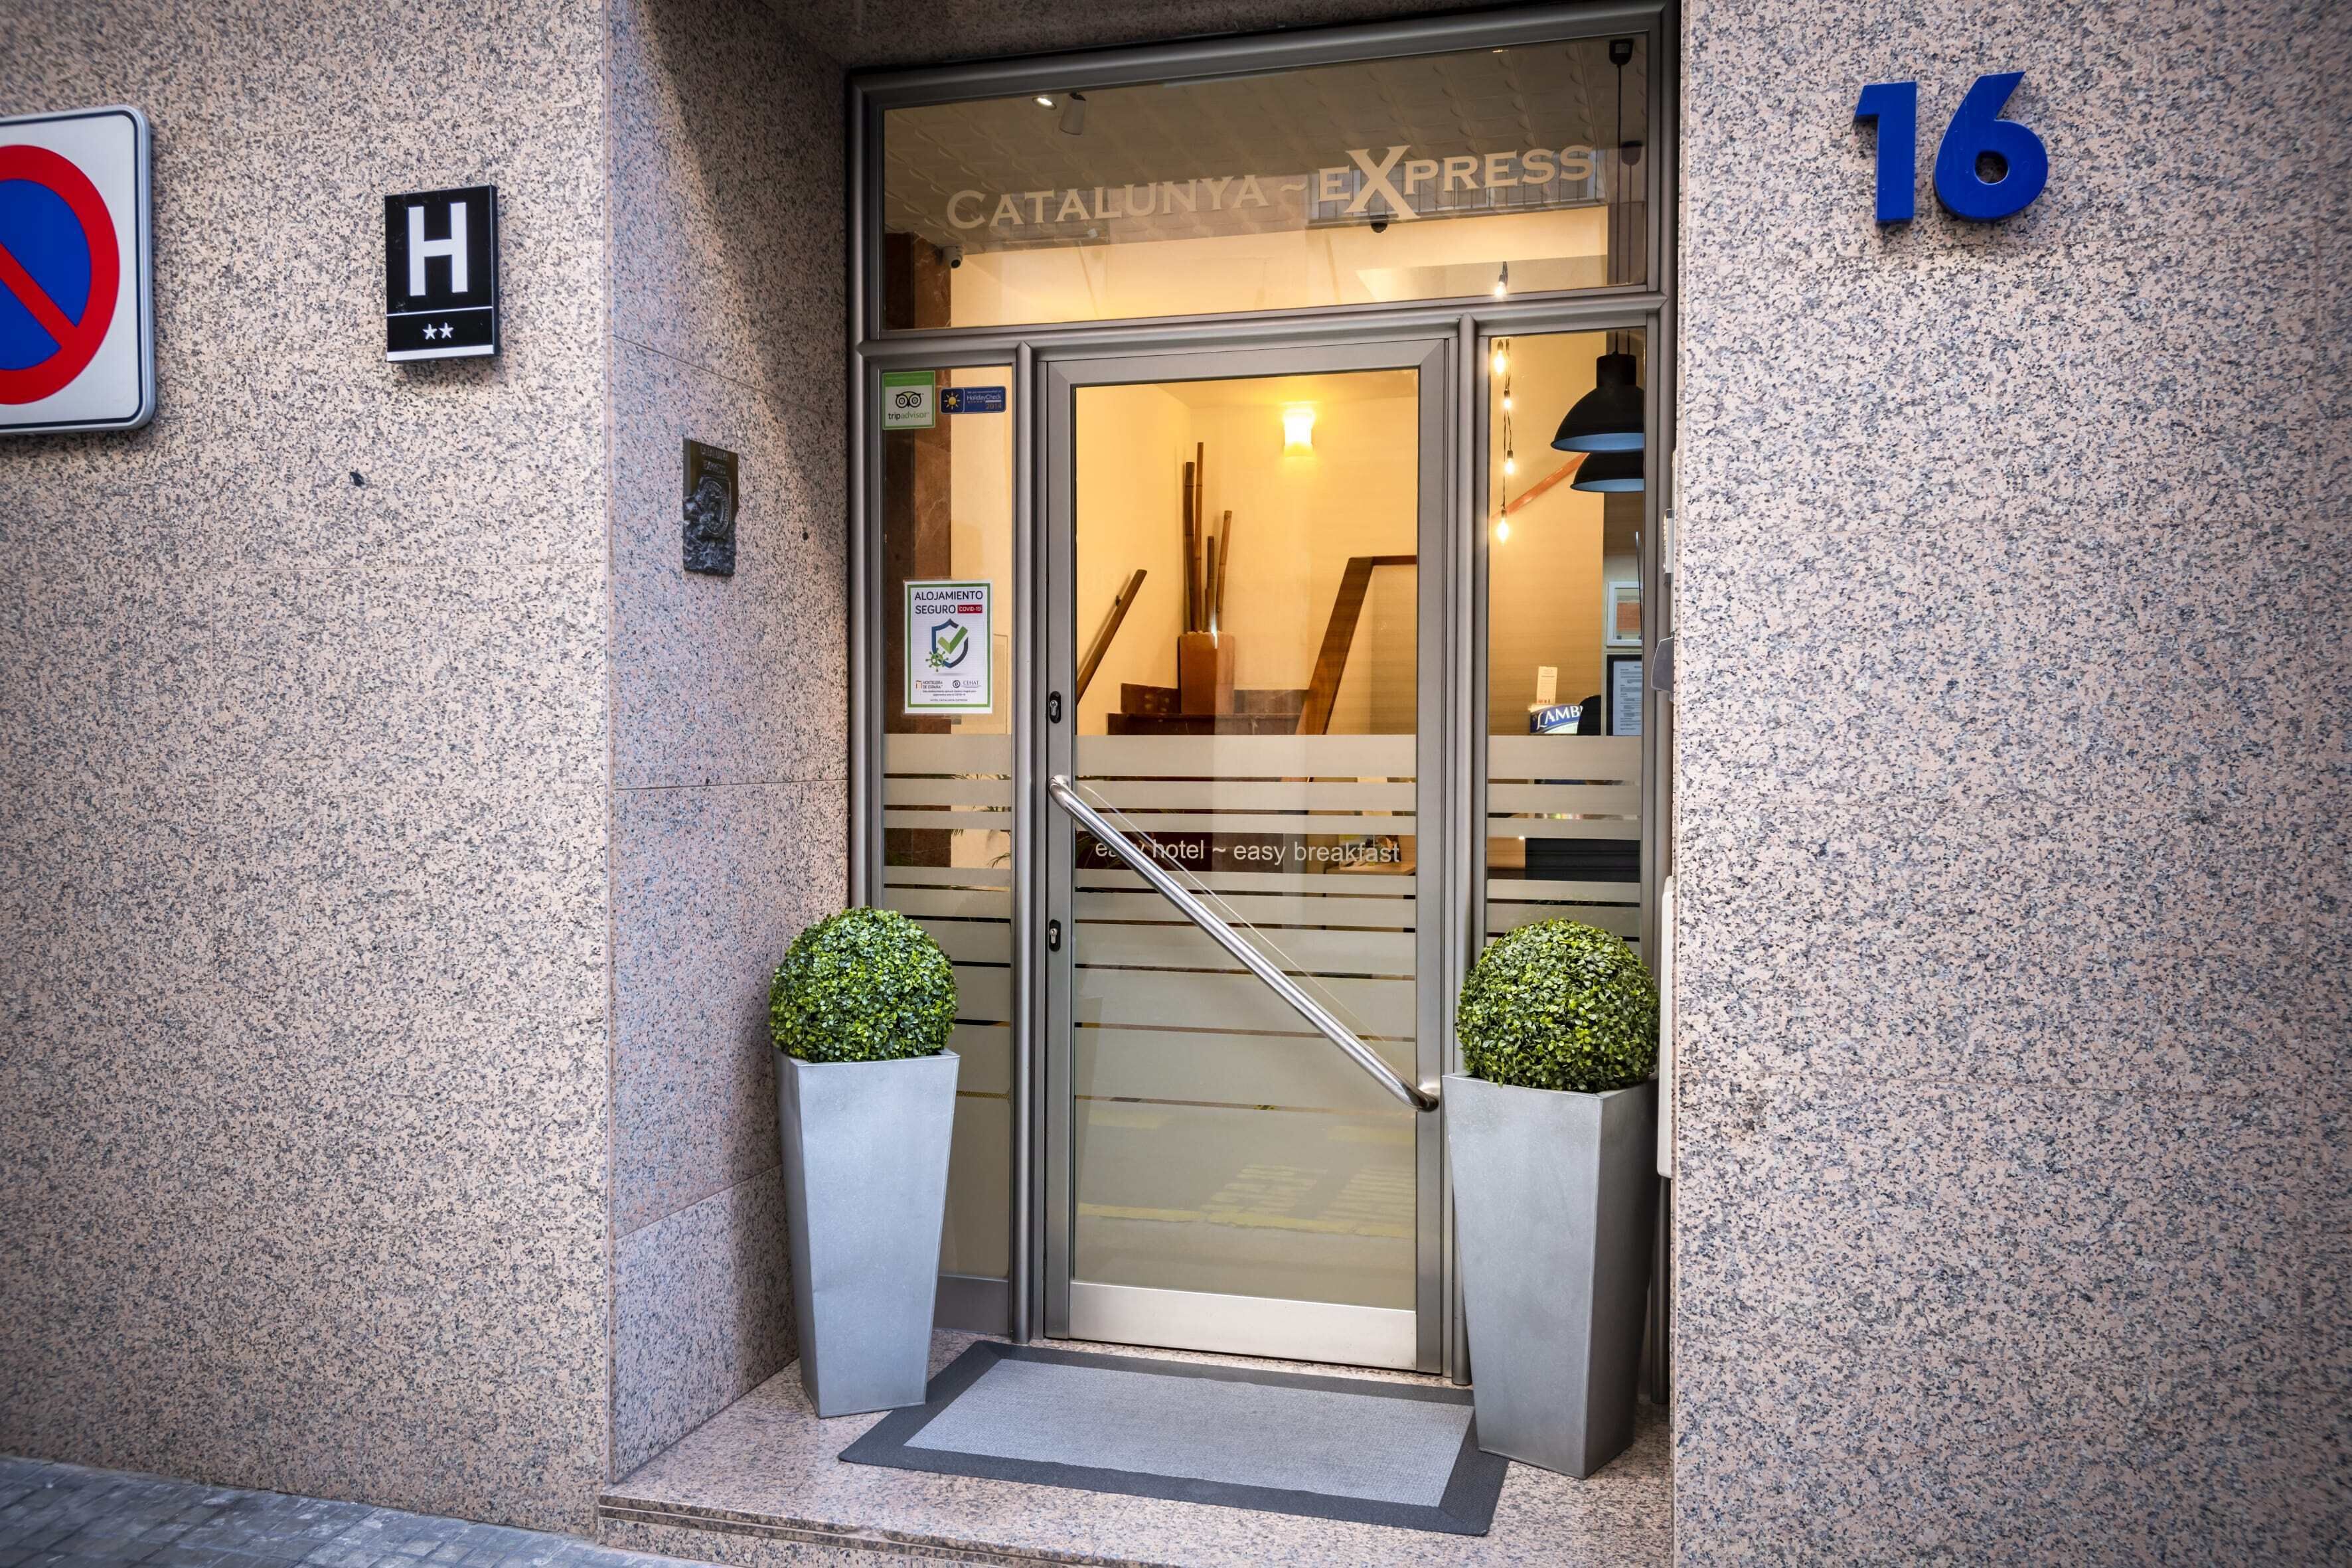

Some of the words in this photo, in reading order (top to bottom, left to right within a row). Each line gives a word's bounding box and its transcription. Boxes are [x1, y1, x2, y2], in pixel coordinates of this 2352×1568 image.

[1853, 71, 2049, 223] 16
[947, 175, 1269, 229] CATALUNYA
[408, 202, 468, 297] H
[967, 394, 1001, 403] HolidayCheck
[888, 412, 926, 421] tripadvisor
[914, 590, 983, 600] ALOJAMIENTO
[915, 605, 956, 614] SEGURO
[1536, 706, 1583, 731] LAMB
[1153, 839, 1204, 859] hotel
[1233, 844, 1287, 866] easy
[1294, 841, 1400, 863] breakfast
